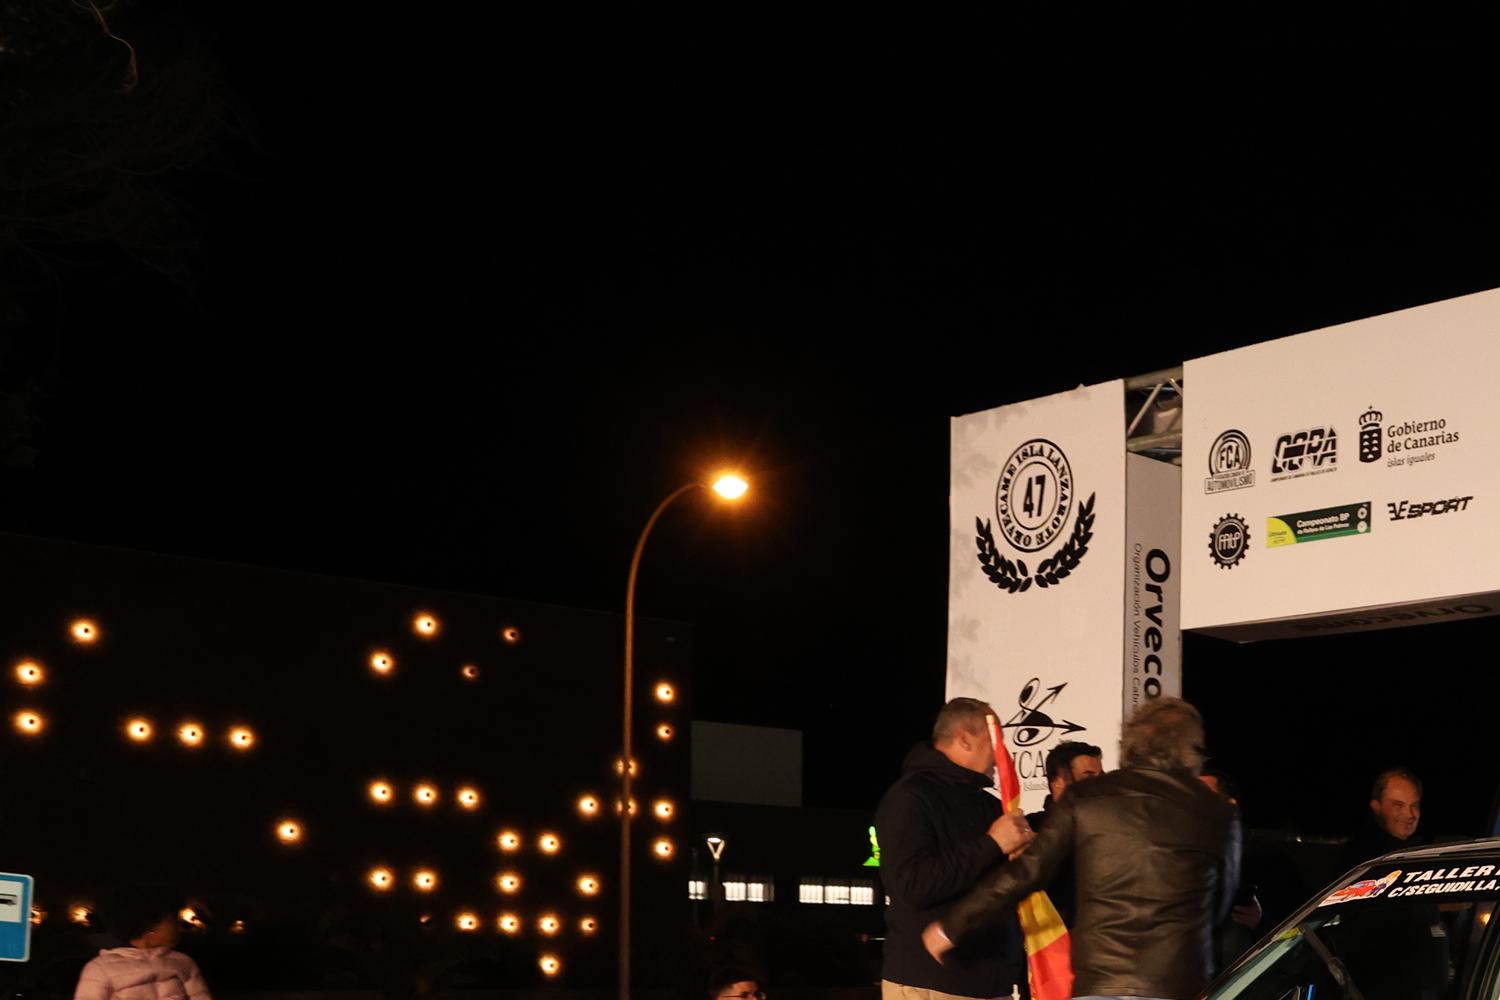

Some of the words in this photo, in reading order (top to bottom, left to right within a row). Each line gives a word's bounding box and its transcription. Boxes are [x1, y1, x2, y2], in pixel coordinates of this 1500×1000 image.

[1387, 417, 1447, 439] Gobierno
[1386, 440, 1402, 454] de
[1403, 430, 1460, 452] Canarias
[1219, 445, 1241, 470] FCA
[1386, 454, 1405, 468] islas
[1406, 452, 1436, 467] iguales
[1022, 473, 1046, 519] 47
[1291, 604, 1493, 632] Orvecame
[1403, 864, 1496, 884] TALLER
[1387, 879, 1500, 899] C/SEGUIDILLA,
